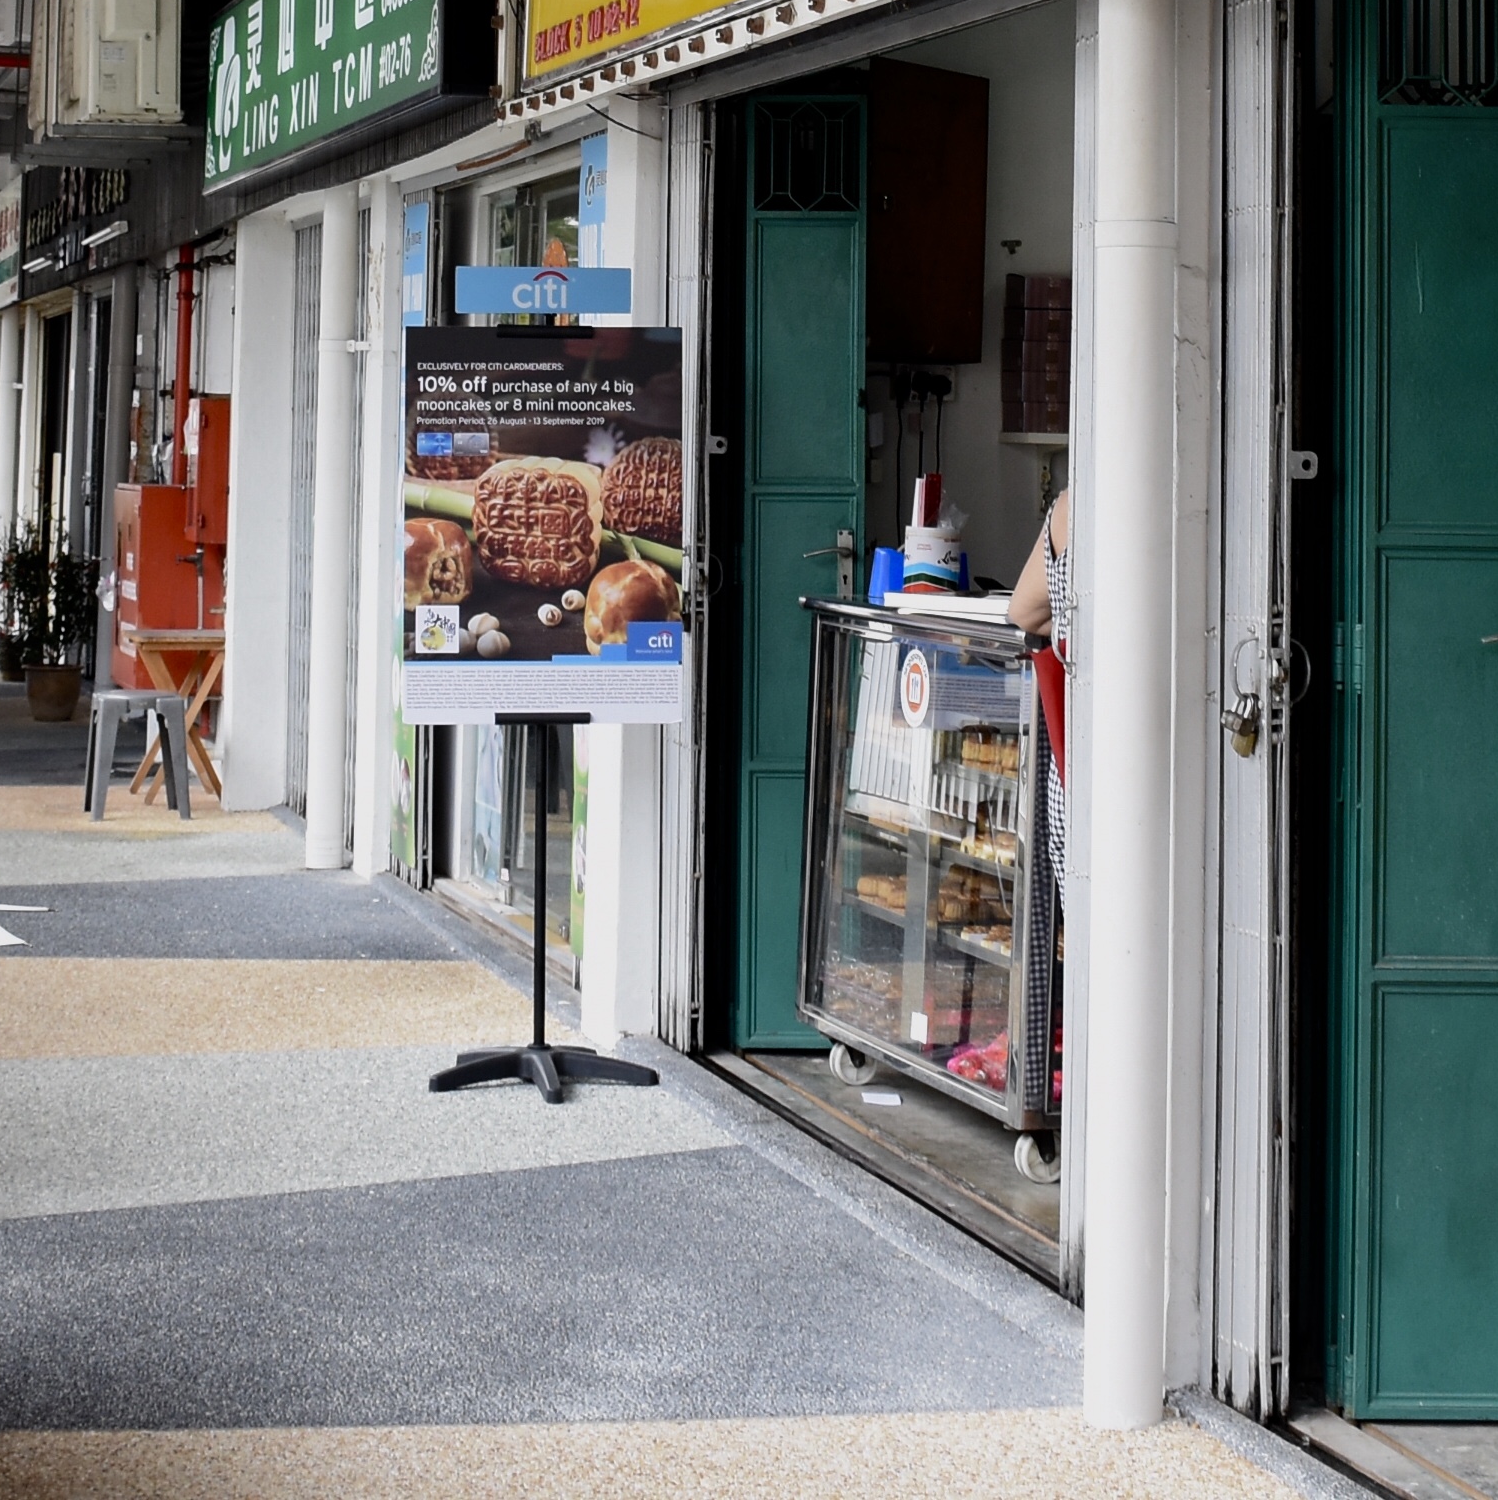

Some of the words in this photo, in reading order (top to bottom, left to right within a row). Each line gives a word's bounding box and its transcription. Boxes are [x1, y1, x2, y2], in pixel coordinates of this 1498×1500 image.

[534, 19, 572, 64] BLOCK
[243, 94, 278, 157] LING
[289, 72, 319, 135] XIN
[332, 43, 372, 114] TCM
[379, 33, 412, 88] #02-76
[512, 271, 568, 309] citi
[417, 362, 468, 371] EXCLUSIVELY
[470, 363, 486, 371] FOR
[488, 363, 502, 371] CITI
[504, 363, 564, 371] CARDMEMBERS:
[418, 376, 457, 393] 10%
[462, 376, 488, 393] off
[492, 380, 552, 395] purchase
[556, 380, 570, 393] of
[574, 383, 597, 395] any
[601, 381, 611, 393] 4
[614, 380, 634, 395] big
[417, 399, 491, 411] mooncakes
[495, 401, 509, 411] or
[513, 399, 522, 411] 8
[526, 399, 554, 411] mini
[558, 399, 635, 412] mooncakes.
[416, 417, 457, 425] Promotion
[459, 417, 485, 425] Period:
[487, 417, 498, 425] 26
[500, 417, 526, 427] August
[533, 417, 541, 425] 13
[543, 417, 584, 427] September
[586, 417, 605, 425] 2019
[648, 631, 673, 648] citi
